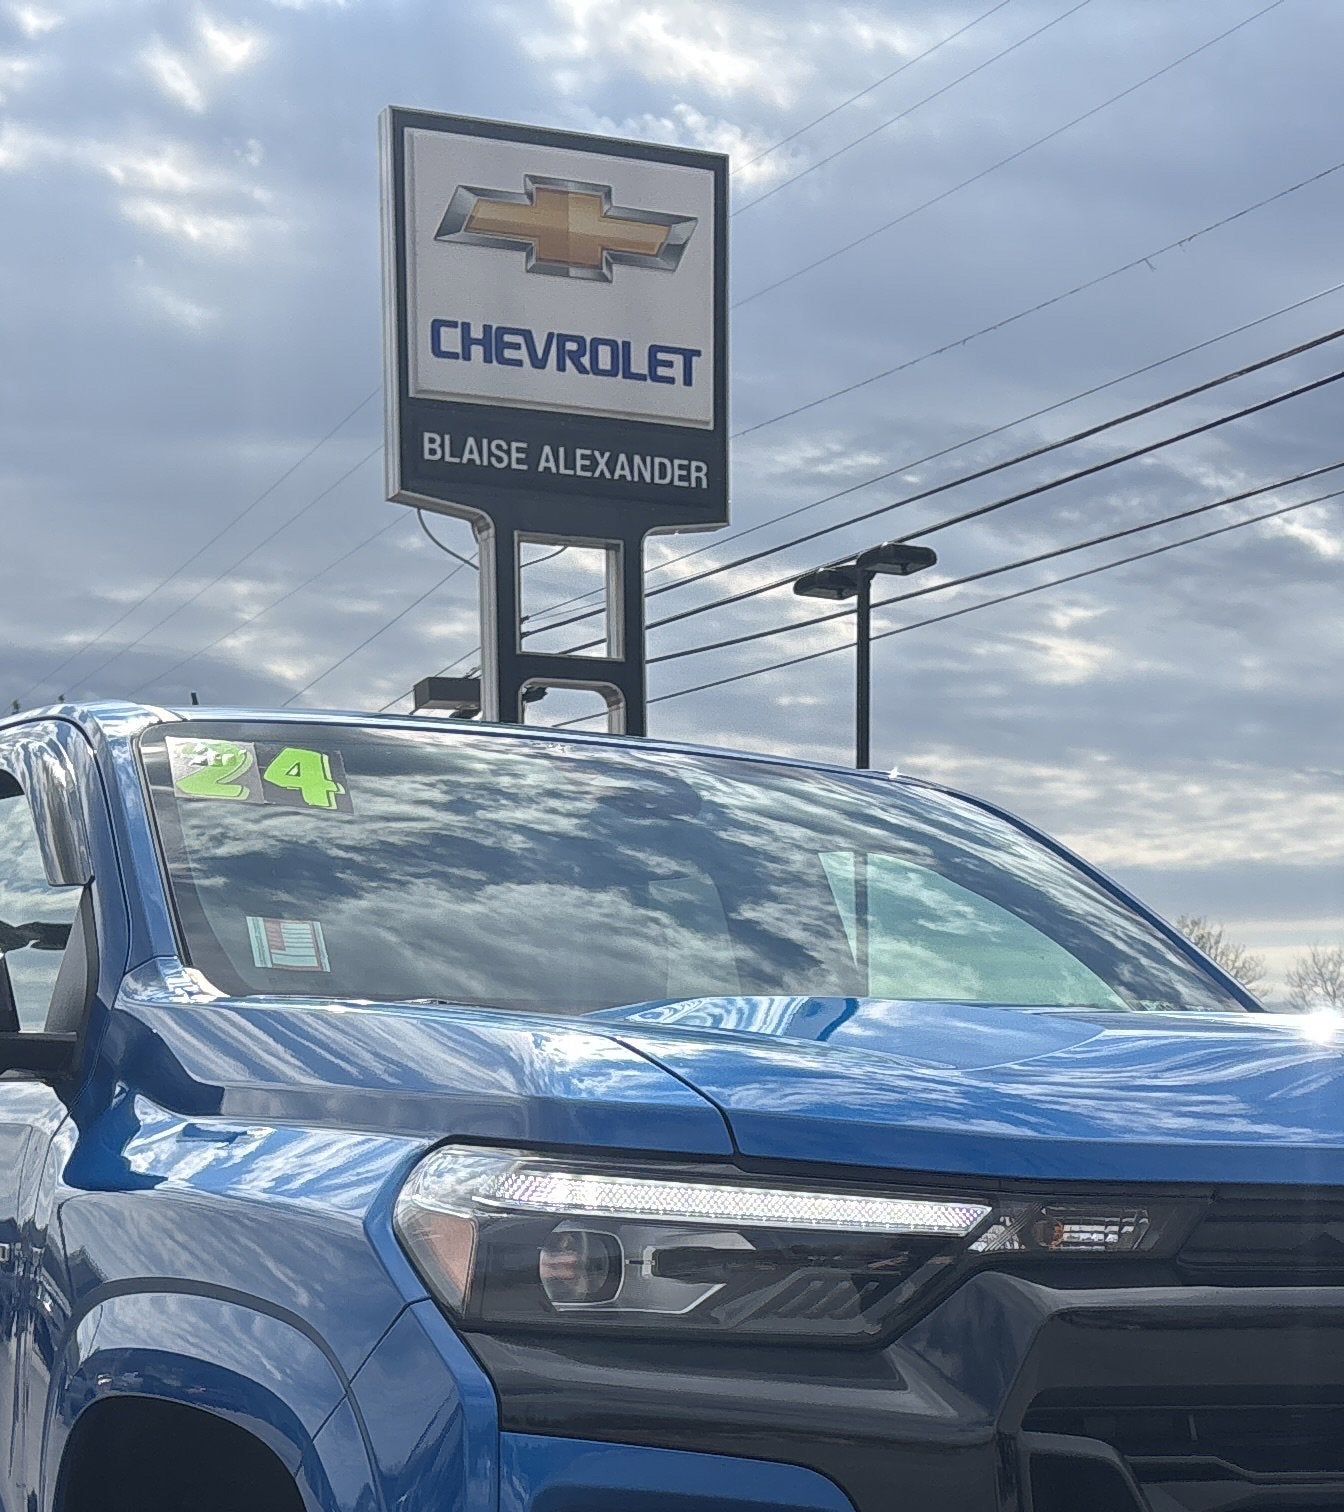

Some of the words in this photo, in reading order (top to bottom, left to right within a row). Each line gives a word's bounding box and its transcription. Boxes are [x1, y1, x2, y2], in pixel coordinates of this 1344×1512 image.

[430, 318, 702, 387] CHEVROLET
[422, 432, 529, 471] BLAISE
[537, 445, 709, 489] ALEXANDER
[174, 742, 346, 810] 24
